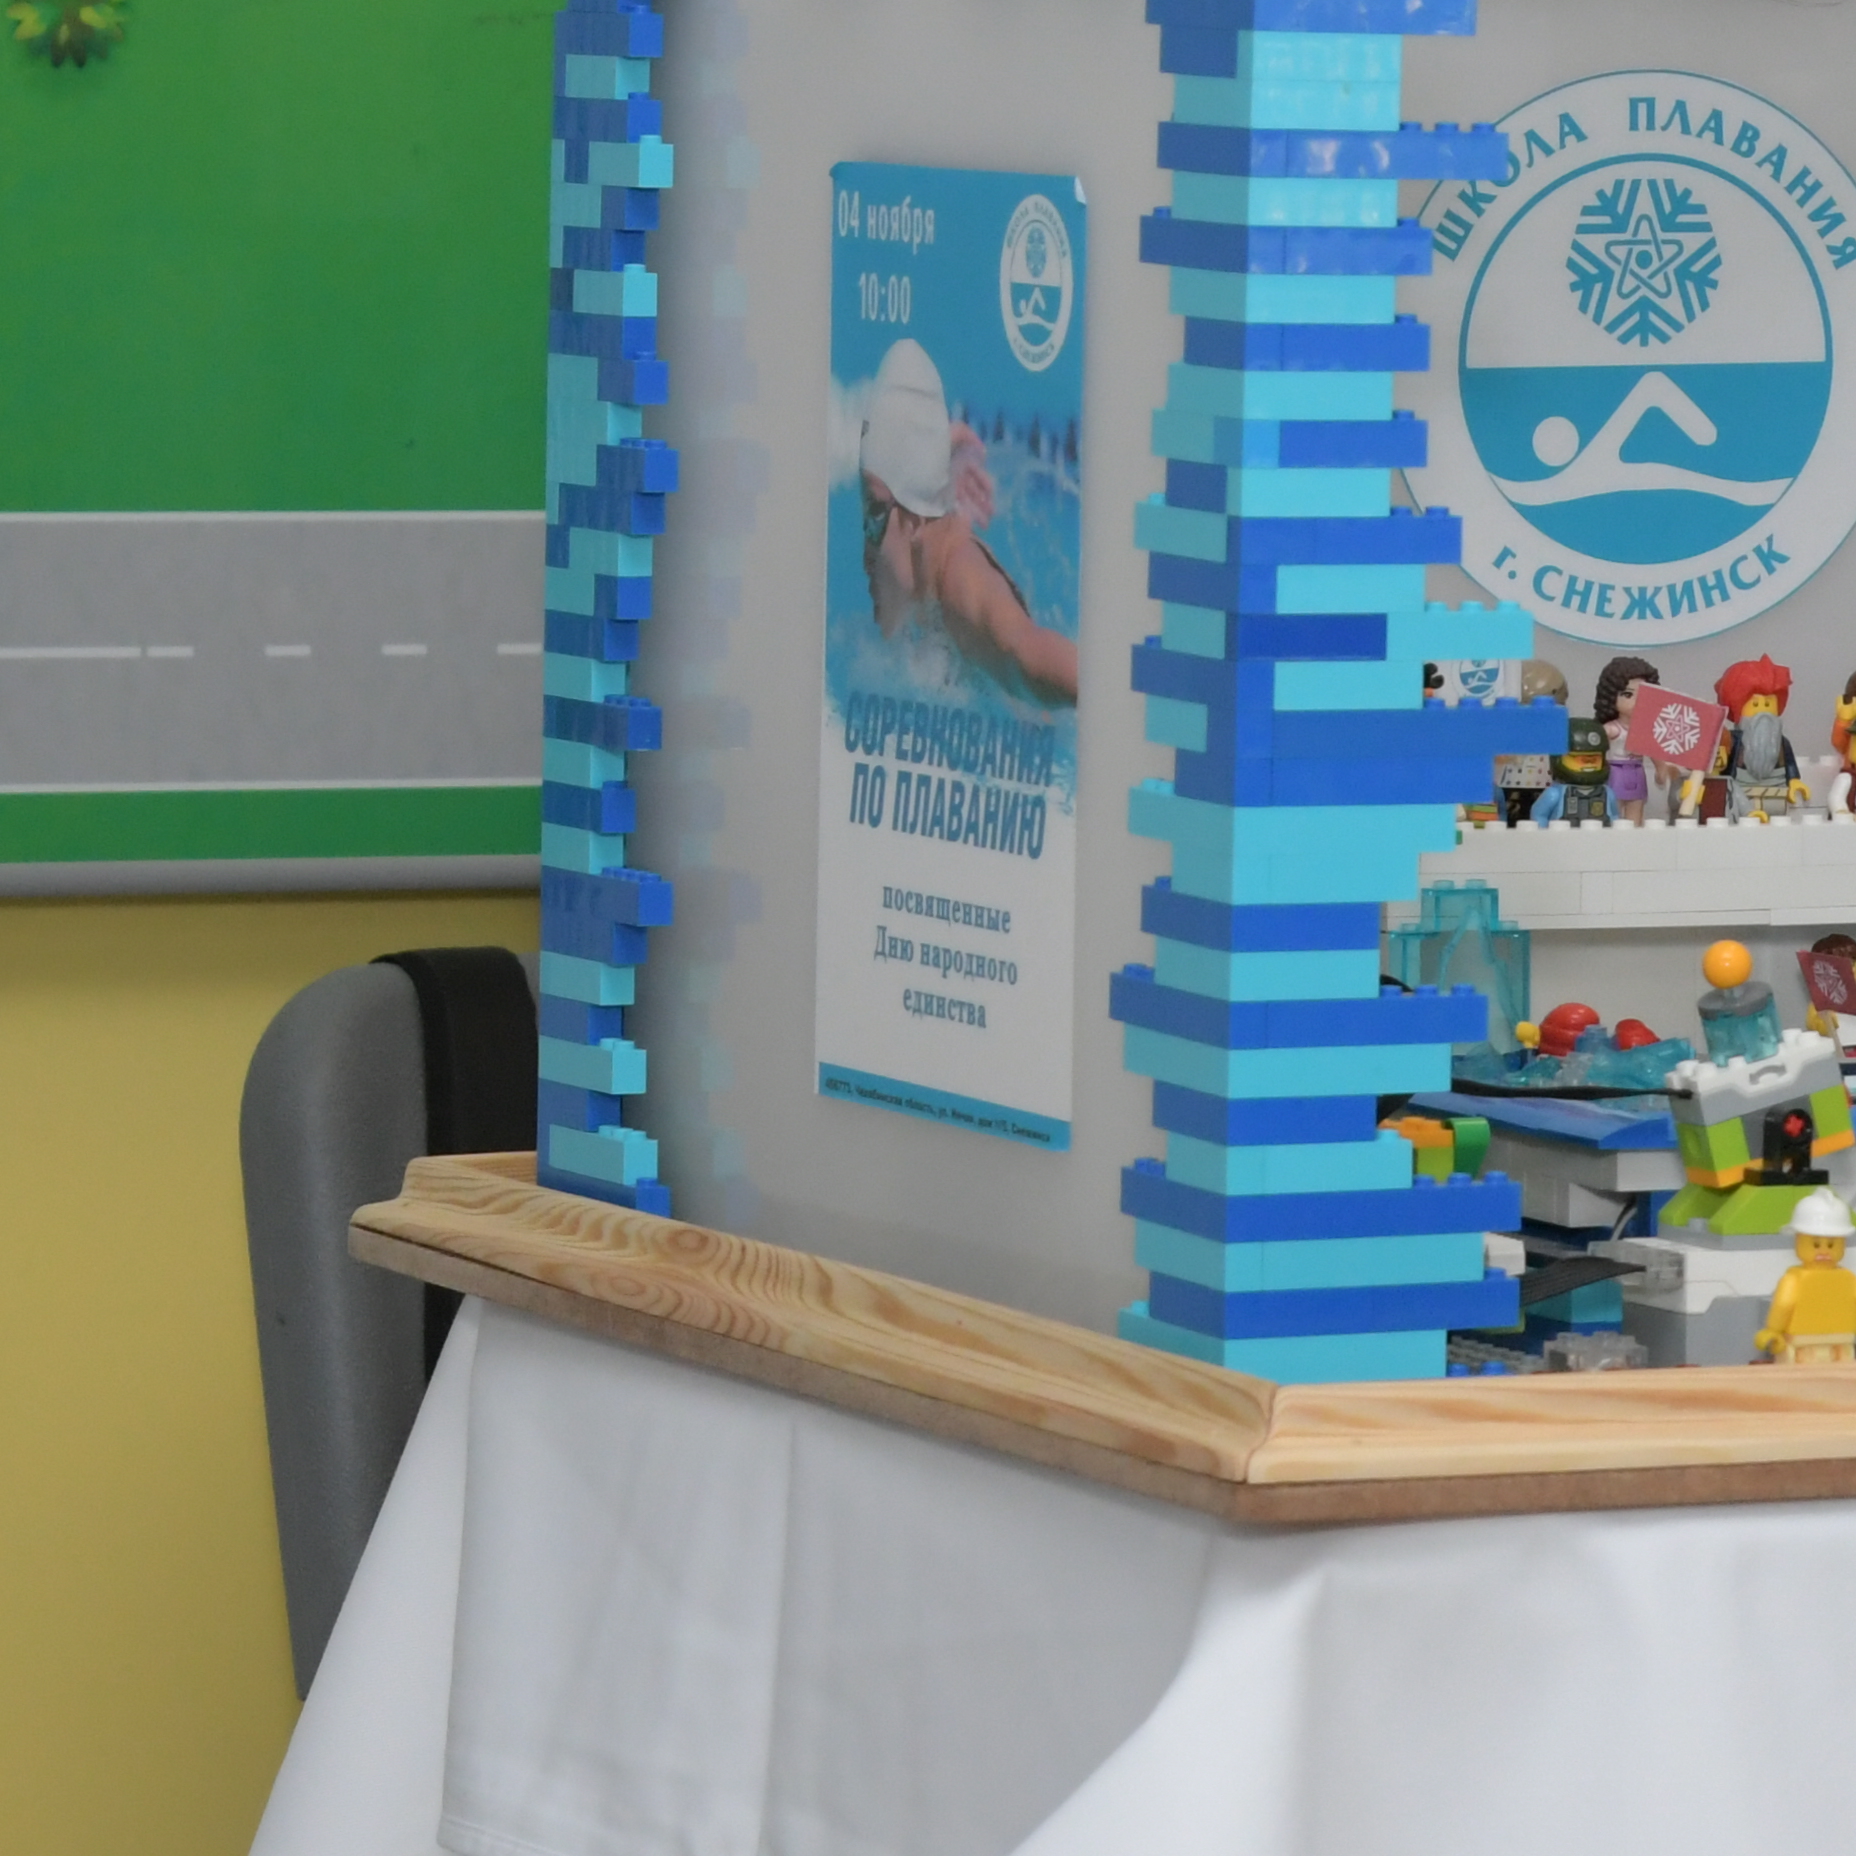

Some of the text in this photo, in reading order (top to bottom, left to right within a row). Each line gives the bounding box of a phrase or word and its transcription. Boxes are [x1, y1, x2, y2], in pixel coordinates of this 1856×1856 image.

[838, 189, 935, 255] 04 ноября
[858, 272, 912, 325] 10:00
[1491, 533, 1791, 621] г. СНЕЖИНСК
[845, 691, 1055, 788] СОРЕВНОВАНИЯ
[850, 762, 1047, 860] ПО ПЛАВАНИЮ
[882, 885, 1011, 934] посвященные
[873, 924, 1018, 986] Дню народного
[902, 988, 987, 1029] единства
